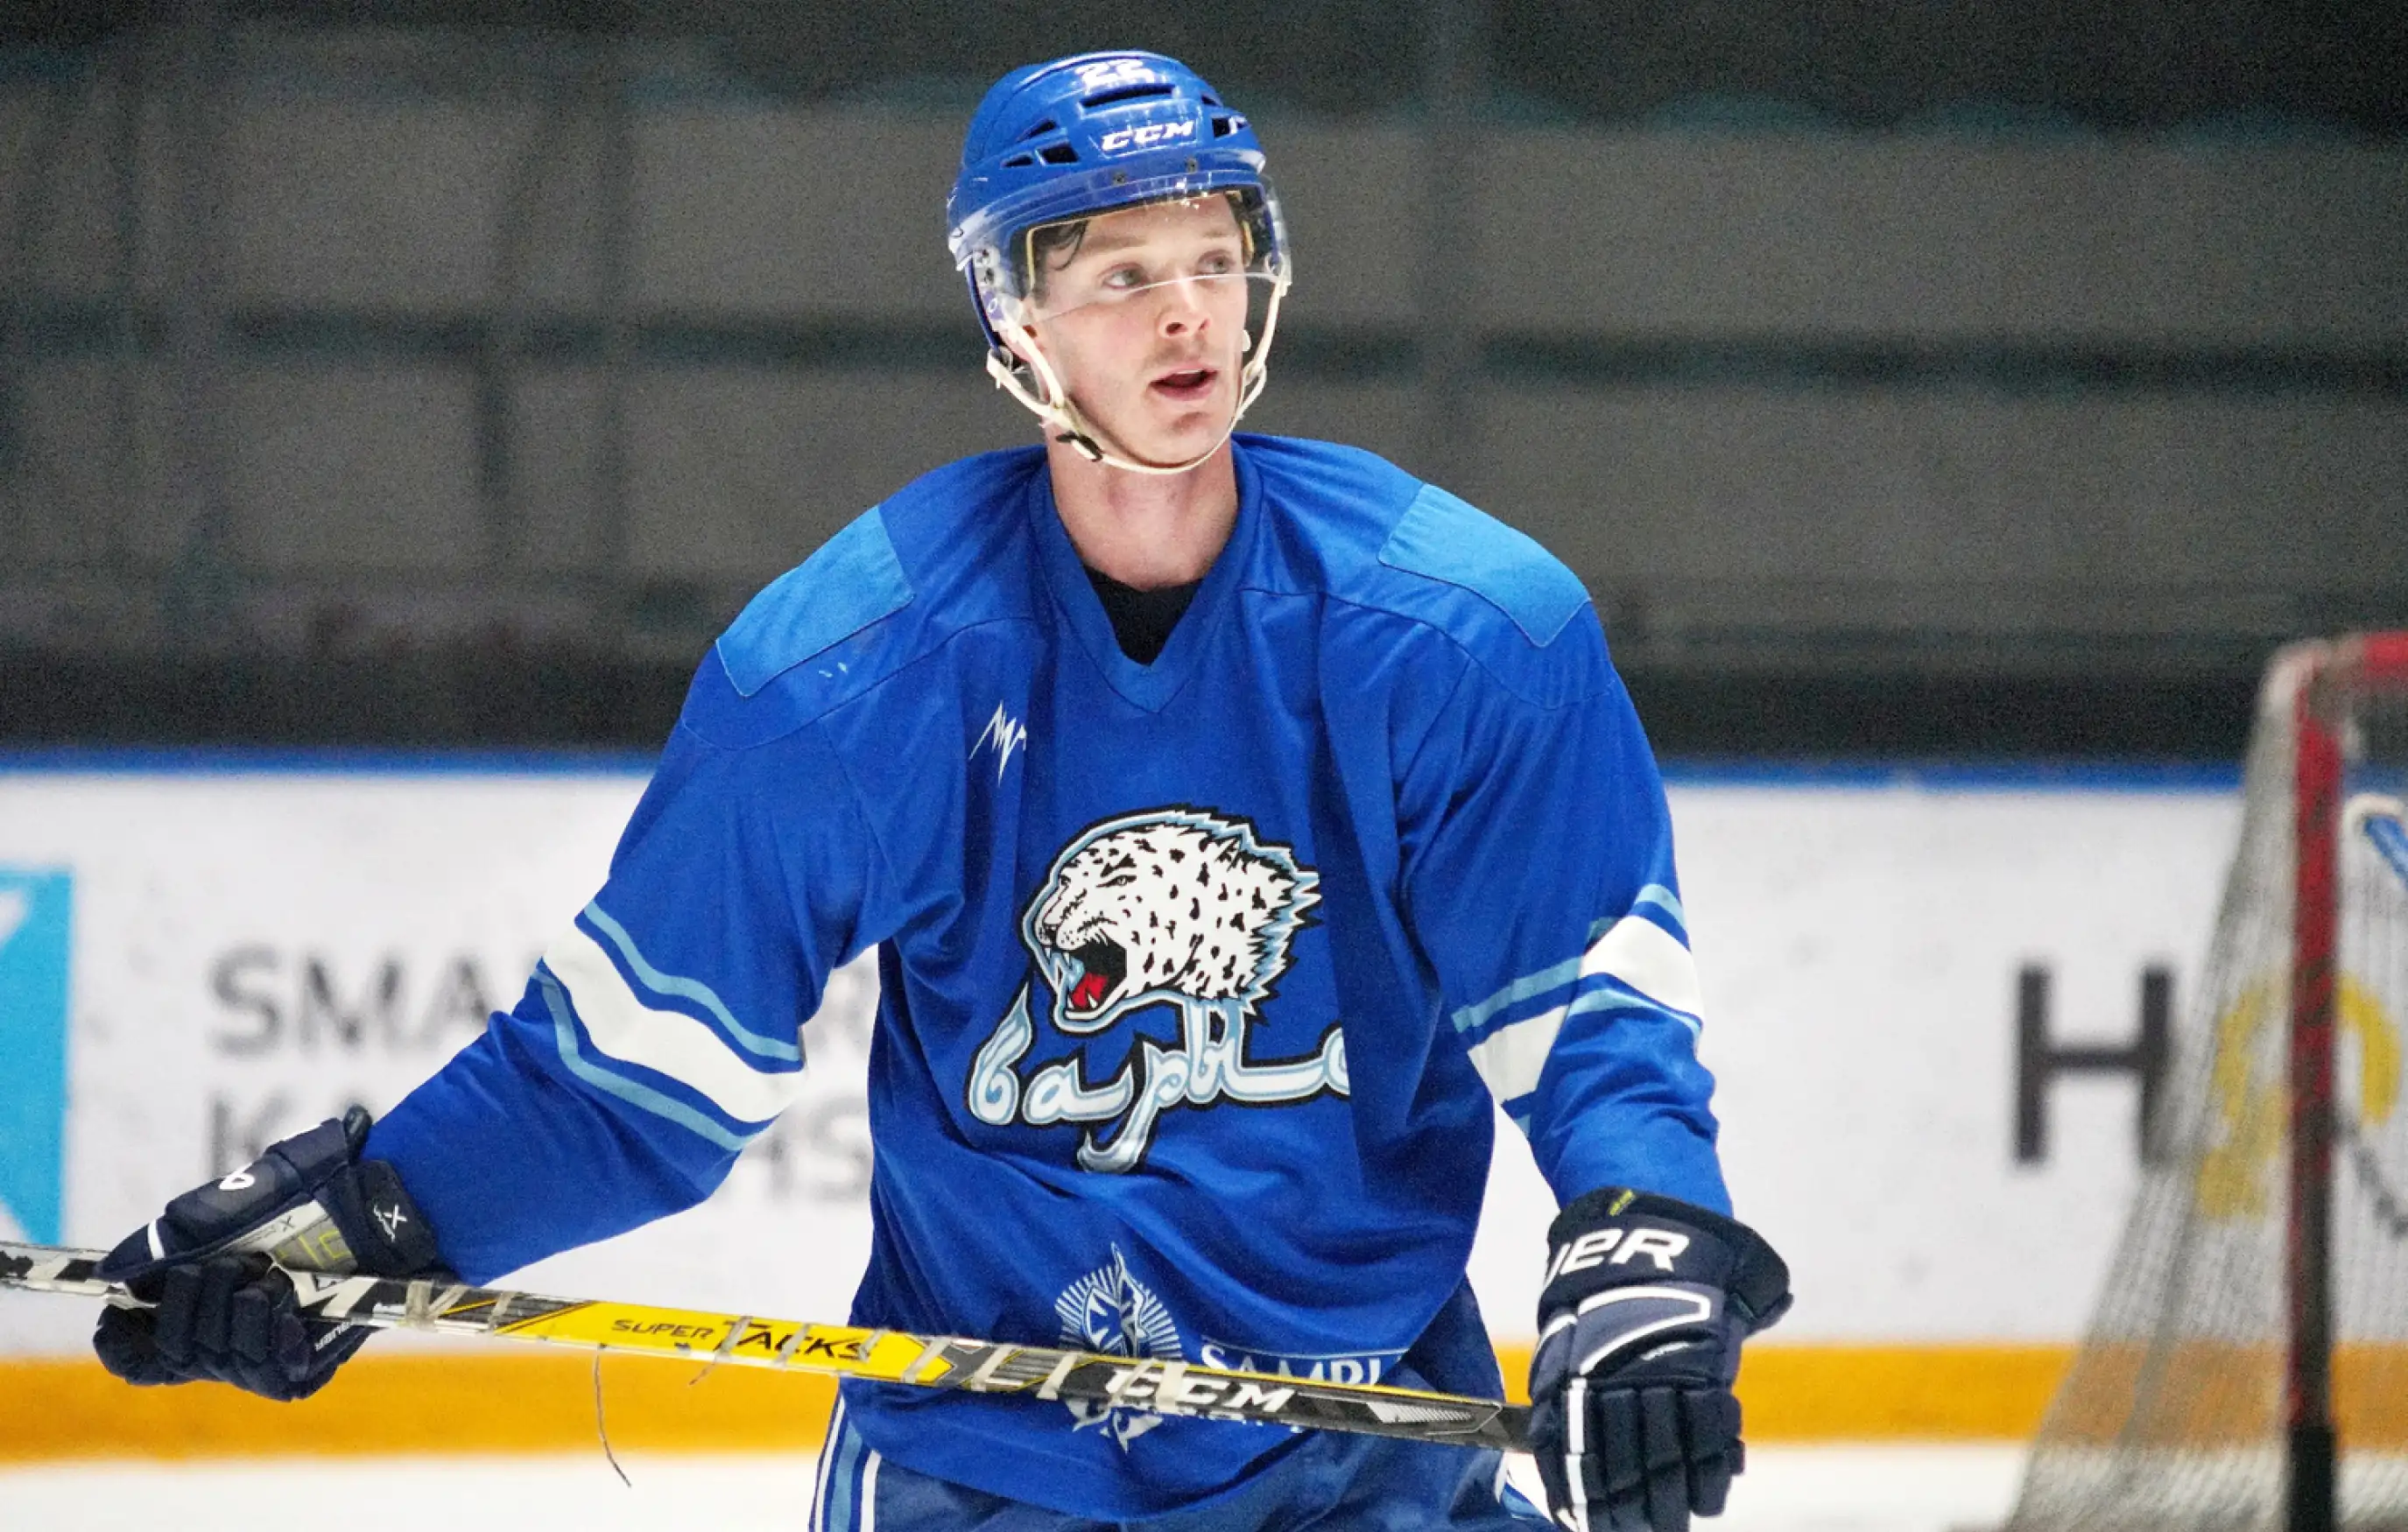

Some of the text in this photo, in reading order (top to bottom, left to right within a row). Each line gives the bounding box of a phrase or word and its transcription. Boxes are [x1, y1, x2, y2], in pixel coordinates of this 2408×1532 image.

[1101, 120, 1195, 151] CCM
[612, 1318, 715, 1340] SUPER
[1105, 1367, 1295, 1414] CCM
